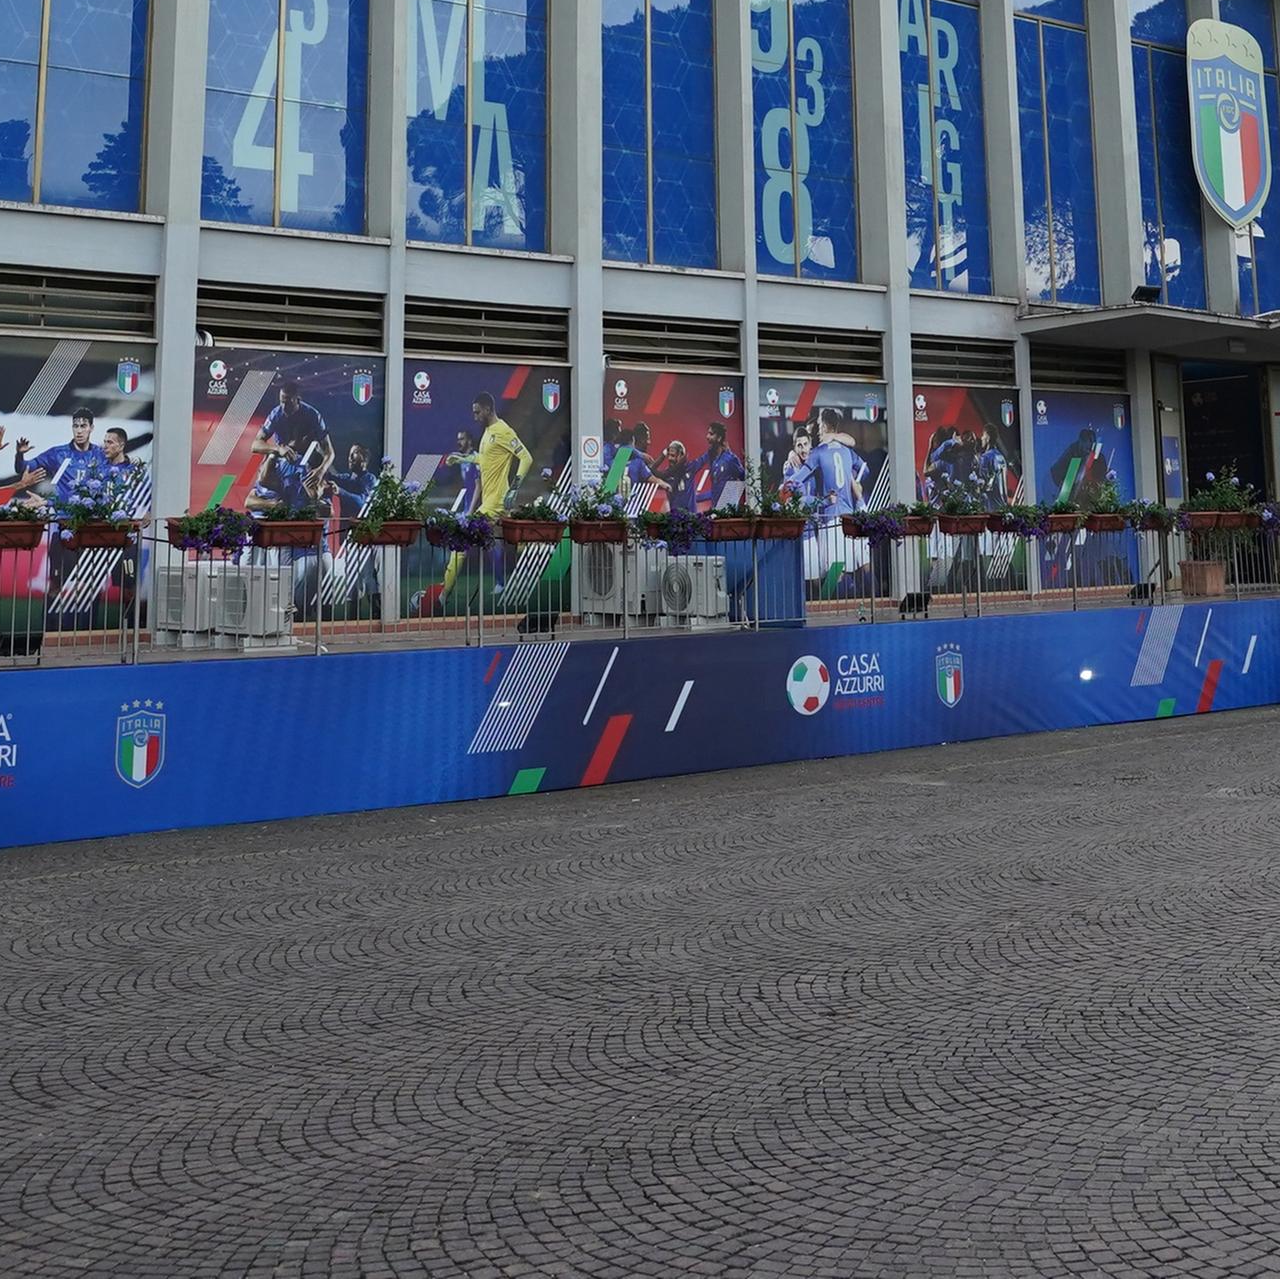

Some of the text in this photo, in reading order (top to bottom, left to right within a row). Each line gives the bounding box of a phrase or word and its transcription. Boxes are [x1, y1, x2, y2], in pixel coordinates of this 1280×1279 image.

[1196, 67, 1257, 101] ITALIA
[837, 653, 880, 676] CASA
[834, 675, 885, 696] AZZURRI
[121, 718, 161, 732] ITALIA
